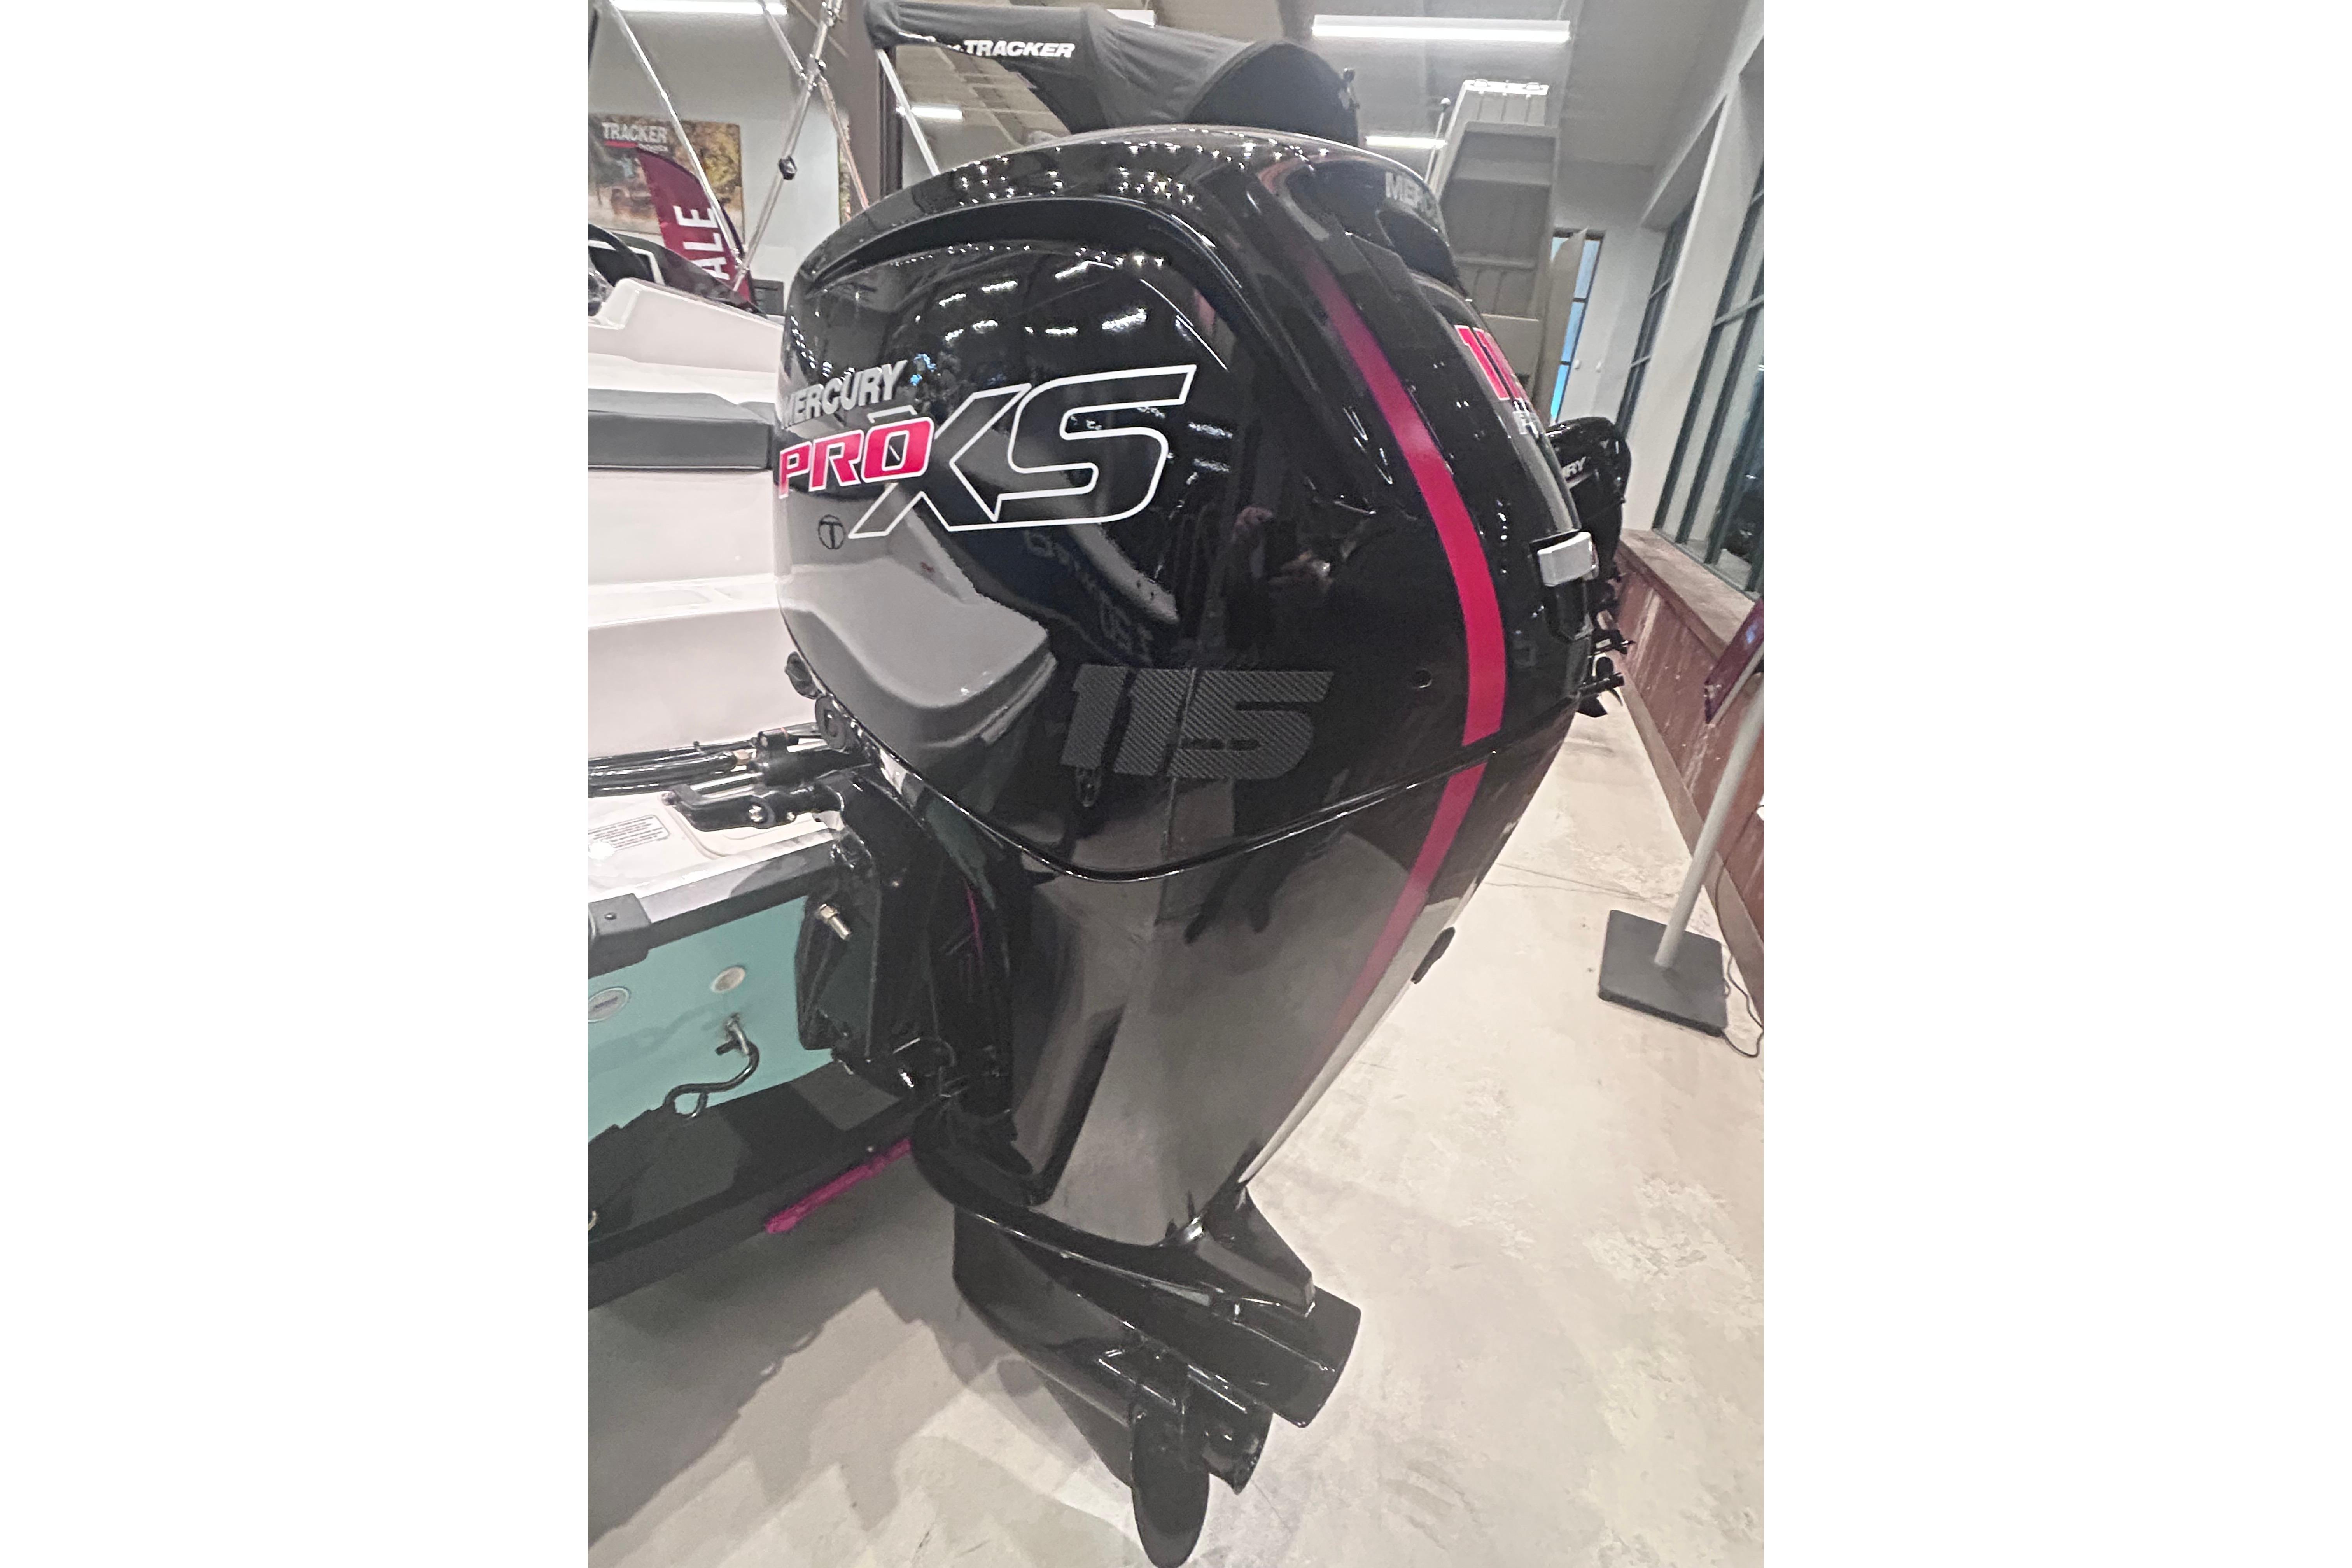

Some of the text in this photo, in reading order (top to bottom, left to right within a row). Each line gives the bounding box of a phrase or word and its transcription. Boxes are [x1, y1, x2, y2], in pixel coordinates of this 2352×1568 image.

[963, 39, 1076, 58] TRACKER
[602, 122, 668, 144] TRACKER
[673, 205, 730, 280] ALE
[779, 364, 1197, 539] PRO XS
[1061, 663, 1335, 778] 115
